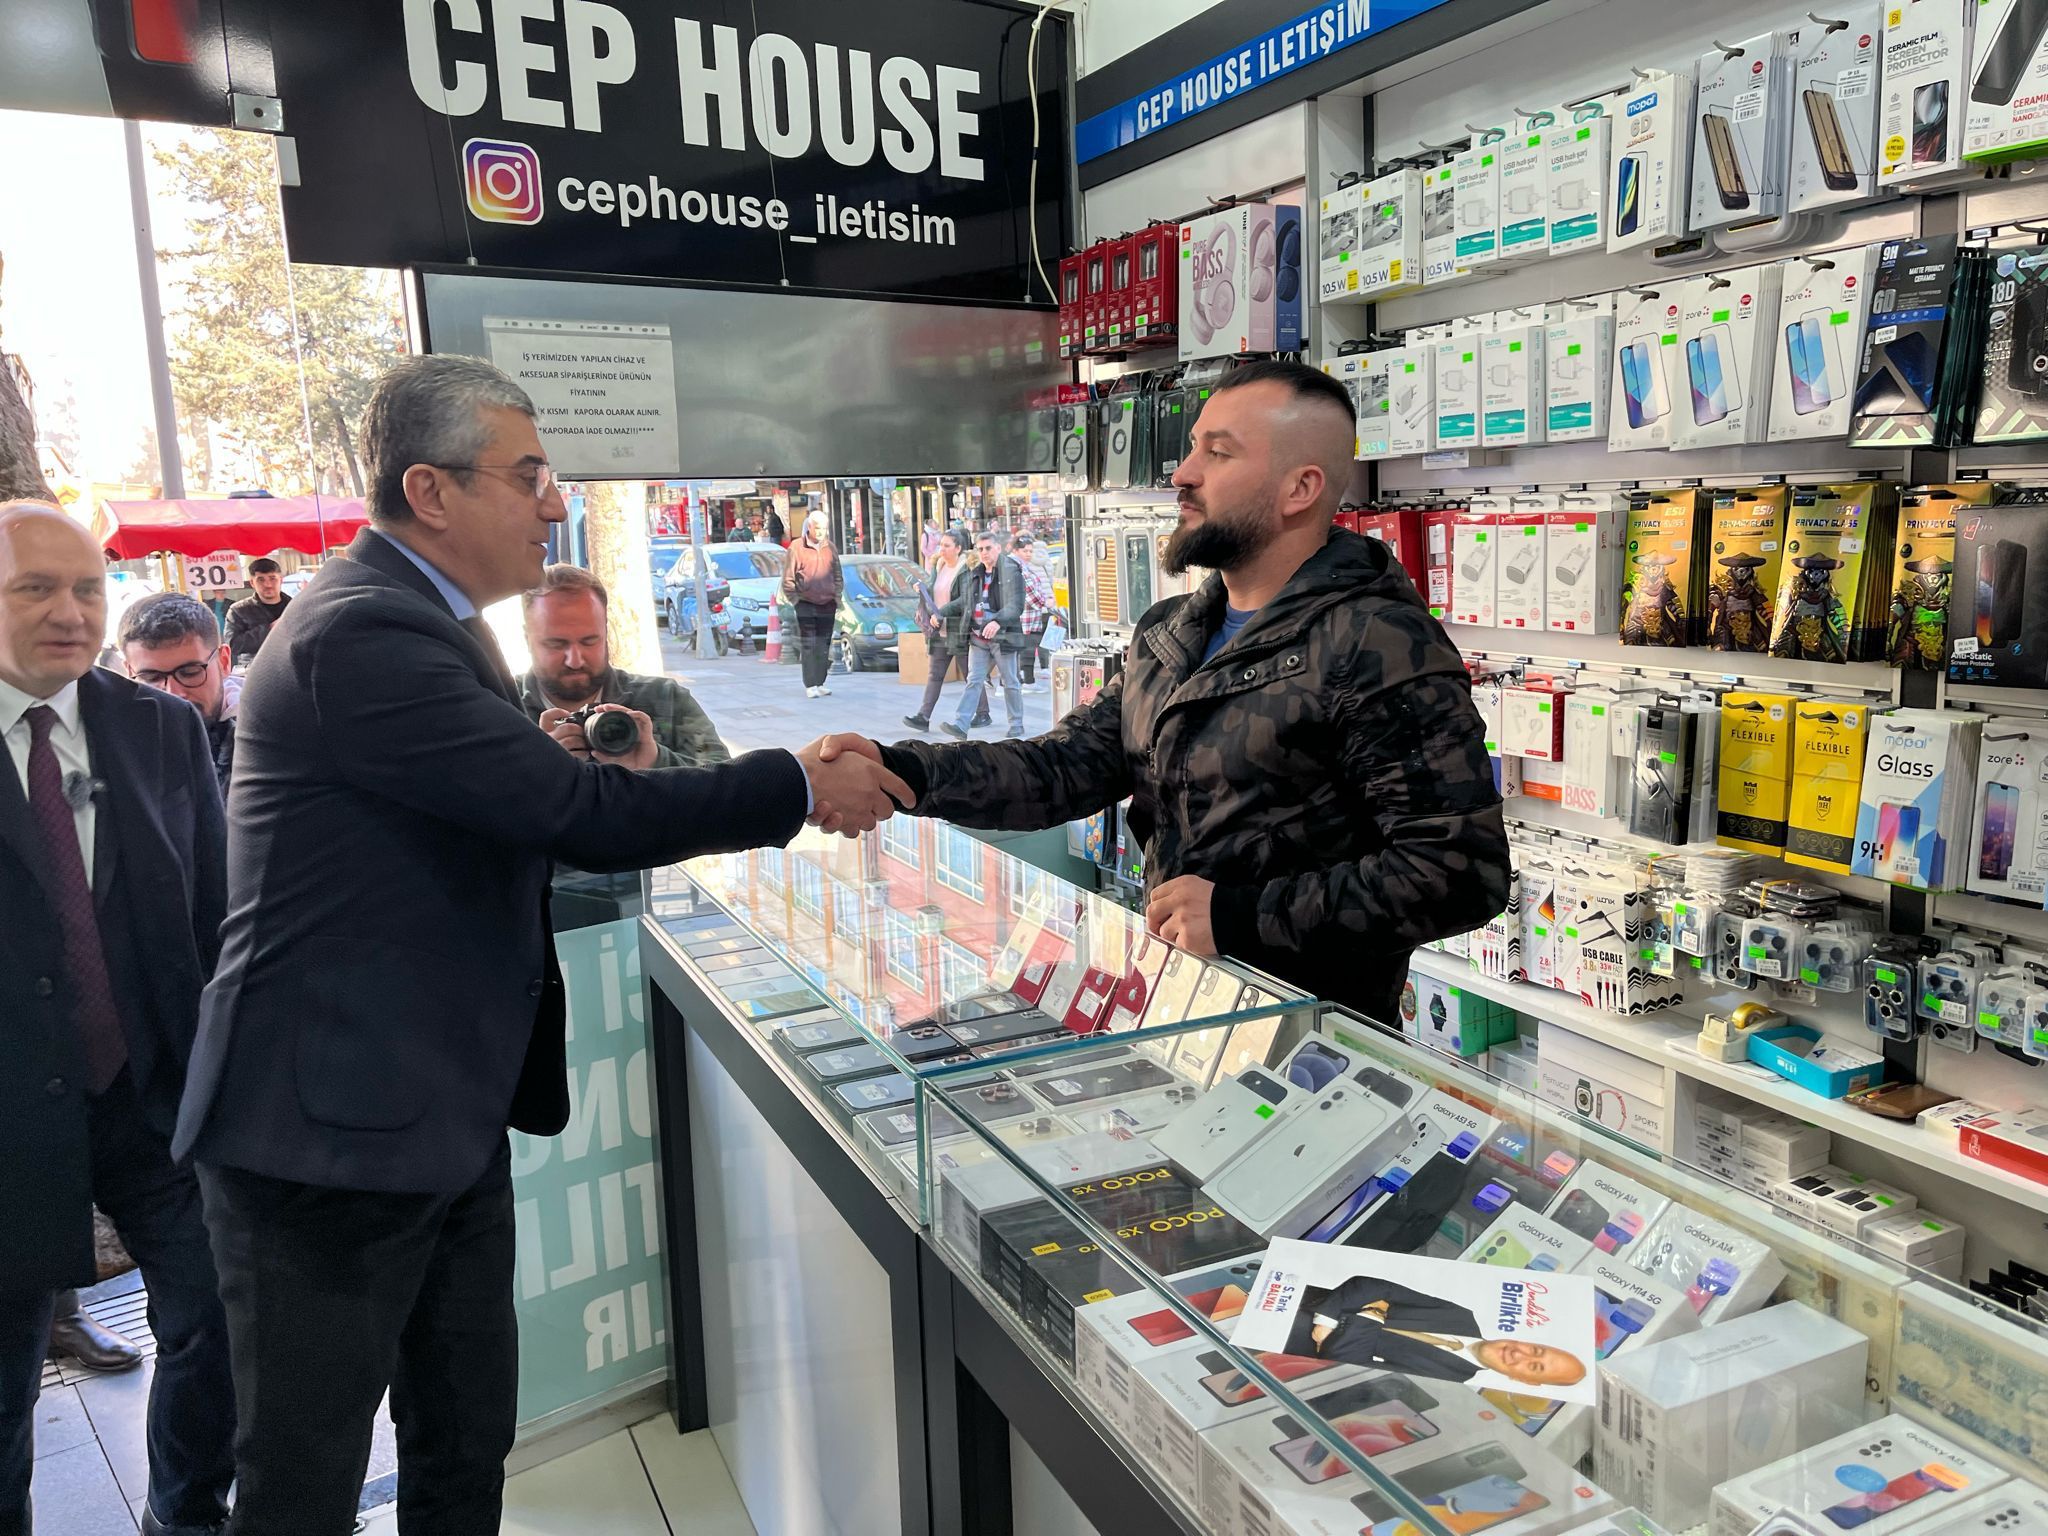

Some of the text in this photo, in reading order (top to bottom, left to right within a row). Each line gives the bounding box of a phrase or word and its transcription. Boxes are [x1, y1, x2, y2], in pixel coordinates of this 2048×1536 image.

[1888, 31, 1938, 54] CERAMIC FILM
[1886, 48, 1949, 74] PROTECTOR
[1887, 44, 1926, 64] SCREEN
[1137, 0, 1370, 133] CEP HOUSE İLETİŞİM
[1801, 57, 1820, 68] zore
[403, 0, 984, 181] CEP HOUSE
[1701, 82, 1718, 94] zore
[1628, 94, 1657, 116] mopal
[1504, 143, 1522, 152] OUTOS
[1551, 136, 1569, 146] OUTOS
[1503, 161, 1515, 171] USB
[1551, 155, 1564, 165] USB
[1457, 175, 1468, 184] USB
[557, 175, 956, 246] cephouse_iletisim
[1883, 245, 1899, 261] 9H
[1193, 249, 1223, 283] BASS
[1426, 260, 1455, 277] 10.5 W
[1909, 264, 1945, 275] MATTE PRIVACY
[1362, 270, 1389, 286] 10.5 W
[1914, 274, 1936, 283] CERAMIC
[1322, 279, 1347, 295] 10.5 W
[1991, 280, 2016, 303] 18D
[1785, 292, 1803, 303] zore
[1873, 288, 1897, 314] 6D
[1685, 310, 1702, 320] zore
[1618, 319, 1634, 328] zore
[522, 352, 530, 362] İŞ
[531, 353, 578, 362] YERİMİZDEN
[581, 355, 612, 363] YAPILAN
[613, 355, 635, 364] CİHAZ
[519, 371, 652, 381] AKSESUAR SİPARİŞLERİNDE ÜRÜNÜN
[570, 388, 606, 397] FİYATININ
[547, 408, 569, 416] KISMI
[574, 408, 604, 416] KAPORA
[606, 408, 635, 416] OLARAK
[636, 408, 662, 416] ALINIR.
[586, 427, 603, 435] İADE
[1719, 519, 1774, 528] PRIVACY GLASS
[1796, 519, 1858, 528] PRIVACY GLASS
[1906, 520, 1945, 529] PRIVACY
[207, 554, 236, 562] MISIR
[189, 565, 226, 587] 30
[1731, 729, 1776, 743] FLEXIBLE
[1885, 735, 1928, 749] mopal
[1806, 741, 1850, 755] FLEXIBLE
[1877, 754, 1934, 777] Glass
[1987, 755, 2013, 764] zore
[1565, 785, 1596, 812] BASS
[1818, 801, 1829, 809] 9H
[1486, 923, 1505, 936] CABLE
[1582, 947, 1623, 965] USB CABLE
[1600, 962, 1612, 971] 33W
[1433, 1103, 1477, 1129] Galaxy A53 5G
[1634, 1114, 1658, 1130] SPORTS
[1497, 1136, 1524, 1151] KVK
[1400, 1156, 1412, 1165] 5G
[1071, 1168, 1173, 1196] POCO X5
[1594, 1178, 1639, 1205] Galaxy A14
[1116, 1207, 1226, 1239] POCO X5
[1518, 1220, 1563, 1250] Galaxy A24
[1684, 1225, 1735, 1254] Galaxy A14
[1274, 1271, 1283, 1281] CHP
[1283, 1286, 1295, 1294] S.
[1597, 1266, 1662, 1305] Galaxy M14 5G
[1262, 1284, 1281, 1311] BALYALI
[1498, 1282, 1524, 1333] Birlikte
[1906, 1432, 1946, 1457] Galaxy
